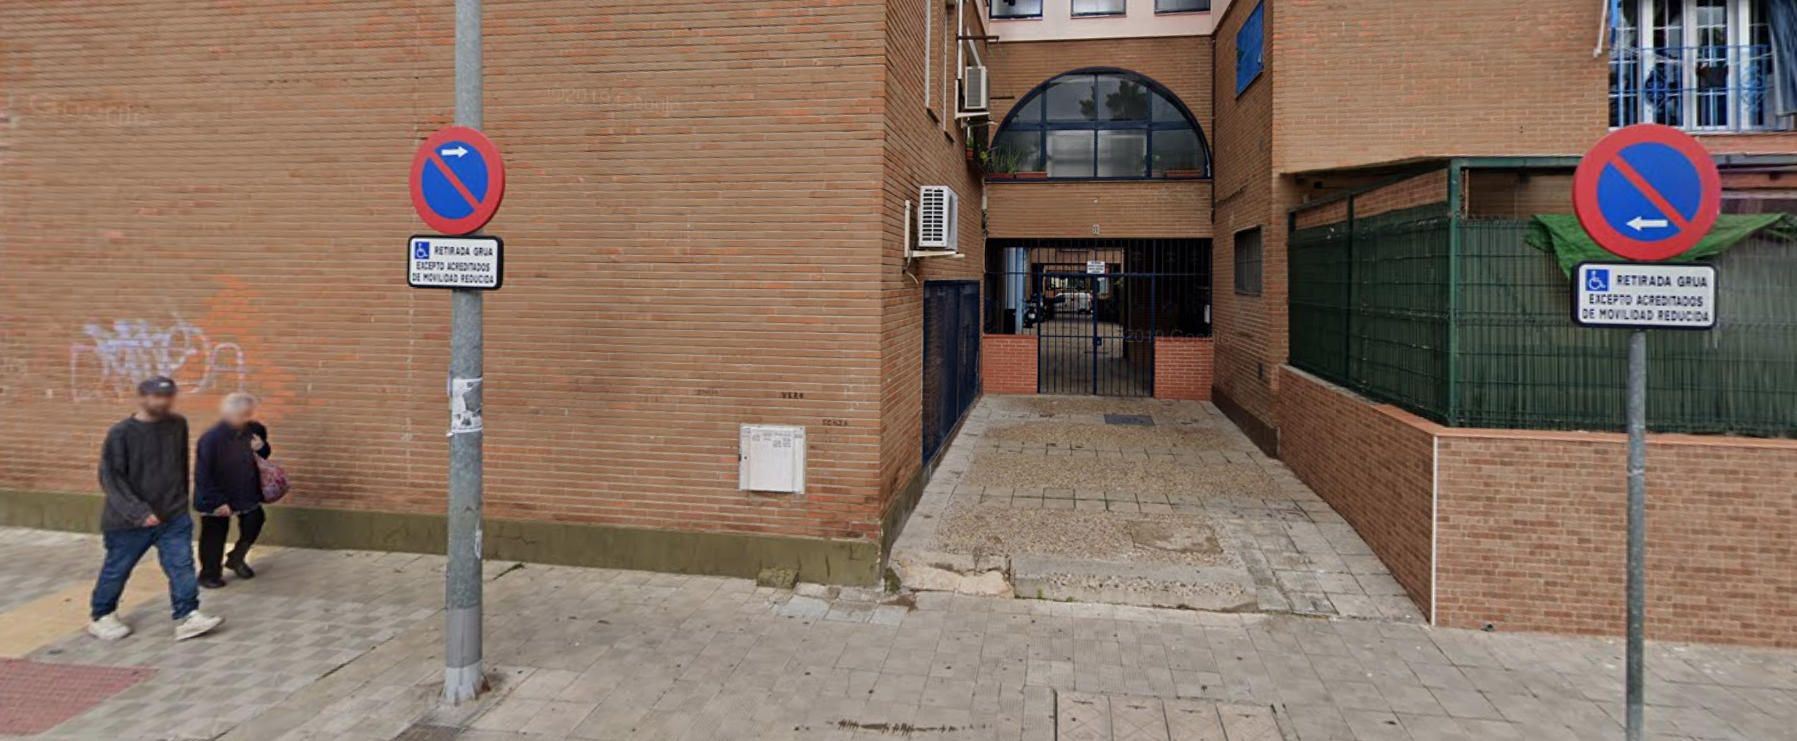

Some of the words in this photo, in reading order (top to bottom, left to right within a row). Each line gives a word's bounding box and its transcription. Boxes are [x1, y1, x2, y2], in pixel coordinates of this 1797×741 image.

[434, 246, 470, 256] RETIRADA
[473, 247, 493, 256] GRUA
[416, 261, 445, 270] EXCEPTO
[447, 262, 490, 272] ACREDITADOS
[412, 272, 421, 282] DE
[423, 273, 458, 283] MOVILIDAD
[461, 274, 494, 283] REDUCIDA
[1616, 275, 1671, 287] RETIRADA
[1677, 276, 1707, 287] GRUA
[1589, 294, 1632, 305] EXCEPTO
[1637, 295, 1703, 307] ACREDITADOS
[1582, 308, 1595, 319] DE
[1599, 309, 1654, 320] MOVILIDAD
[1658, 310, 1709, 322] REDUCIDA
